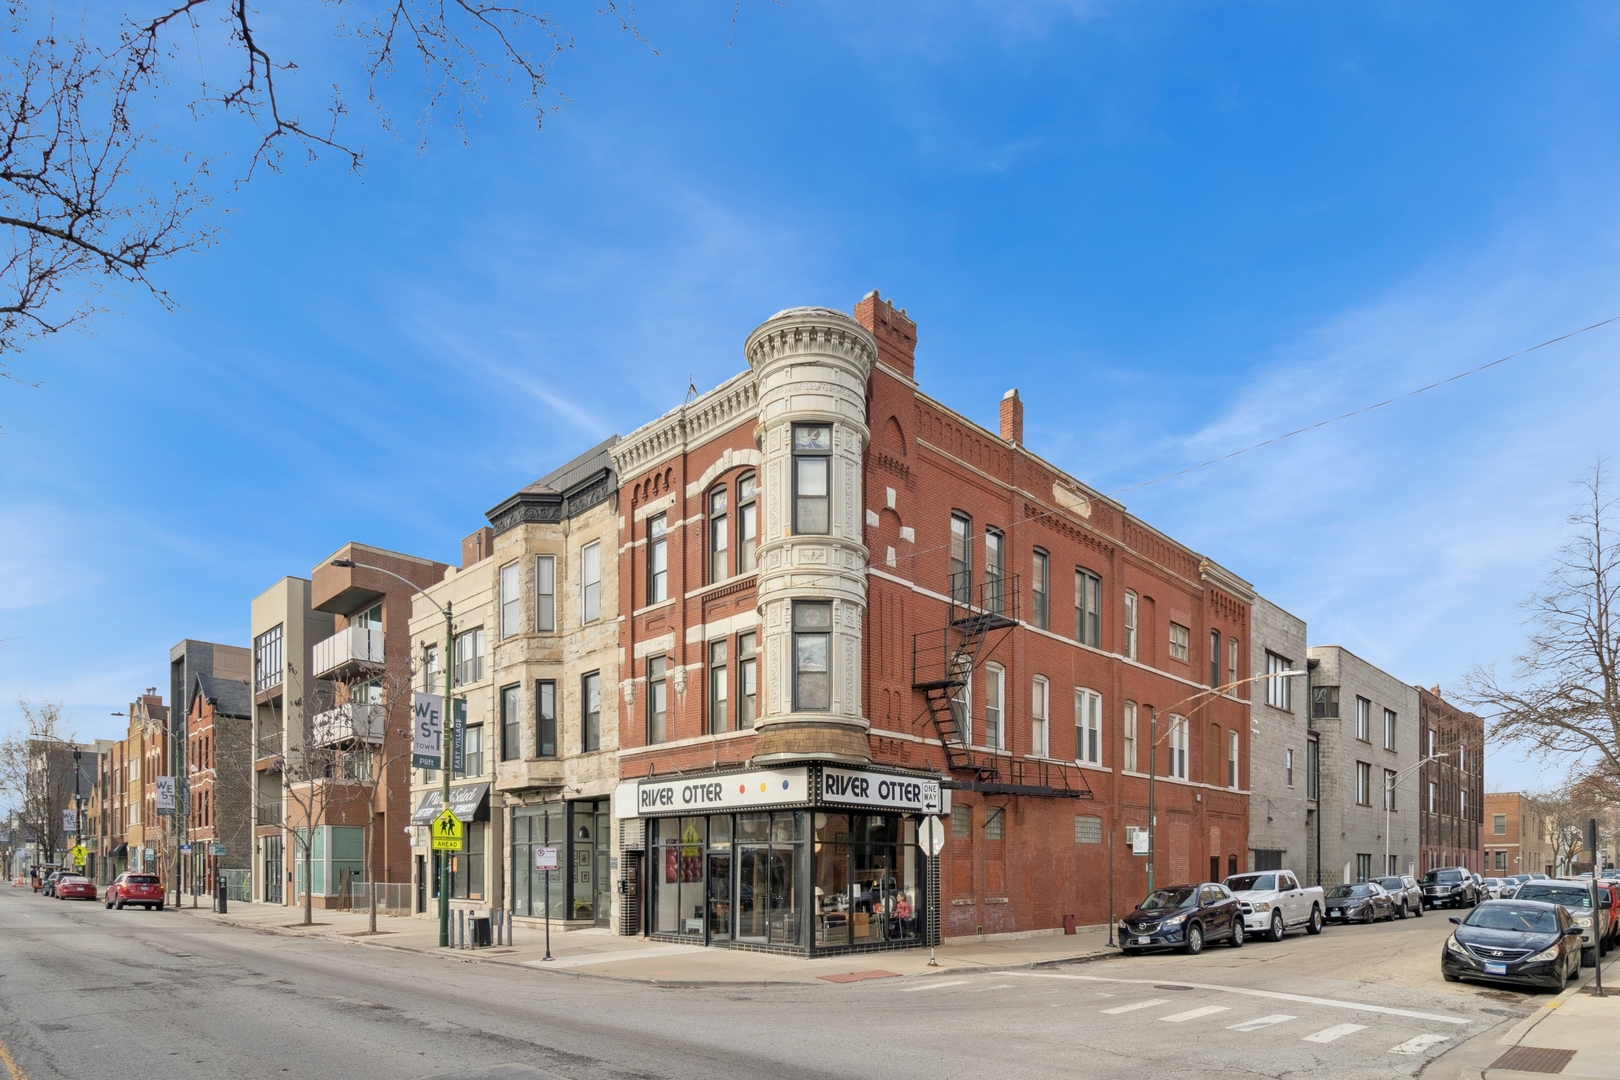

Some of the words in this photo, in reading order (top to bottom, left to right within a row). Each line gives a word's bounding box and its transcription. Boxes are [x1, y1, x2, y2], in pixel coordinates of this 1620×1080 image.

[641, 787, 674, 807] RIVER
[682, 782, 723, 804] OTTER
[825, 773, 870, 798] RIVER
[878, 780, 921, 803] OTTER
[924, 785, 937, 793] ONE
